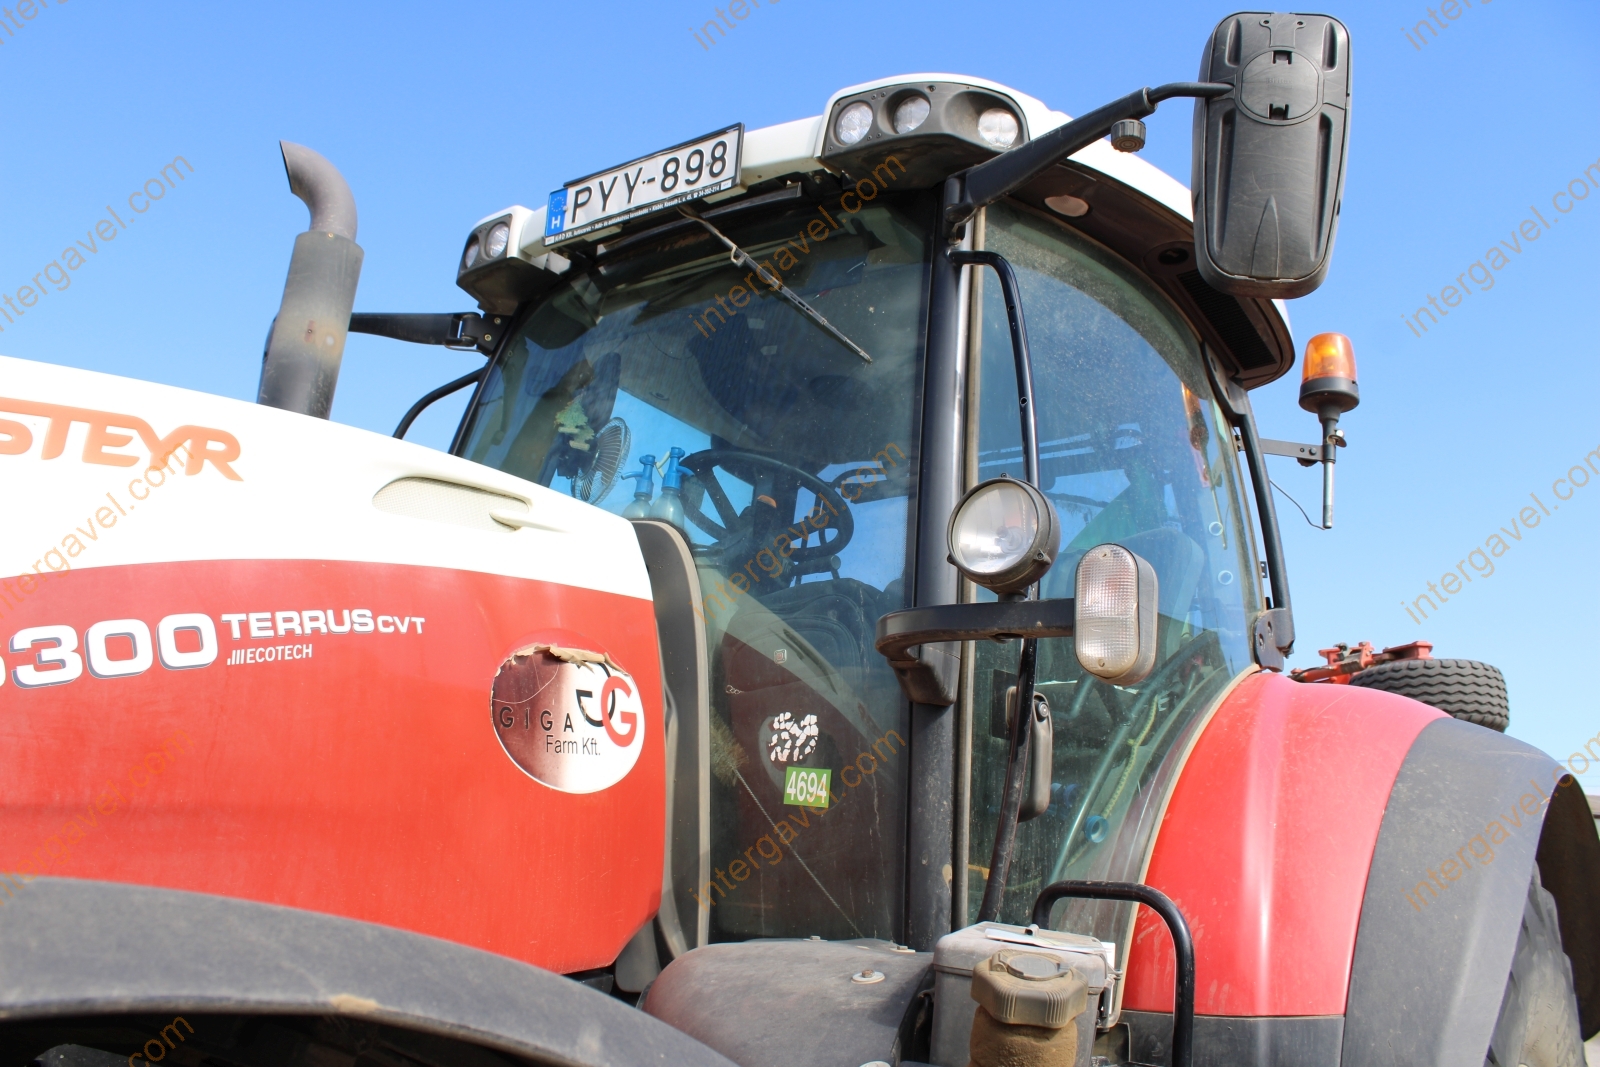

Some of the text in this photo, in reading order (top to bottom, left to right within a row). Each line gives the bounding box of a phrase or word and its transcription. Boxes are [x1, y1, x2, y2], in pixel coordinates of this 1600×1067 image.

[571, 140, 728, 223] PYY-898
[551, 215, 561, 229] H
[0, 397, 244, 482] STEYR
[0, 608, 426, 689] 300 TERRUS CVT
[500, 706, 574, 733] GIGA
[546, 735, 601, 756] Farm Kft.
[786, 771, 828, 804] 4694
